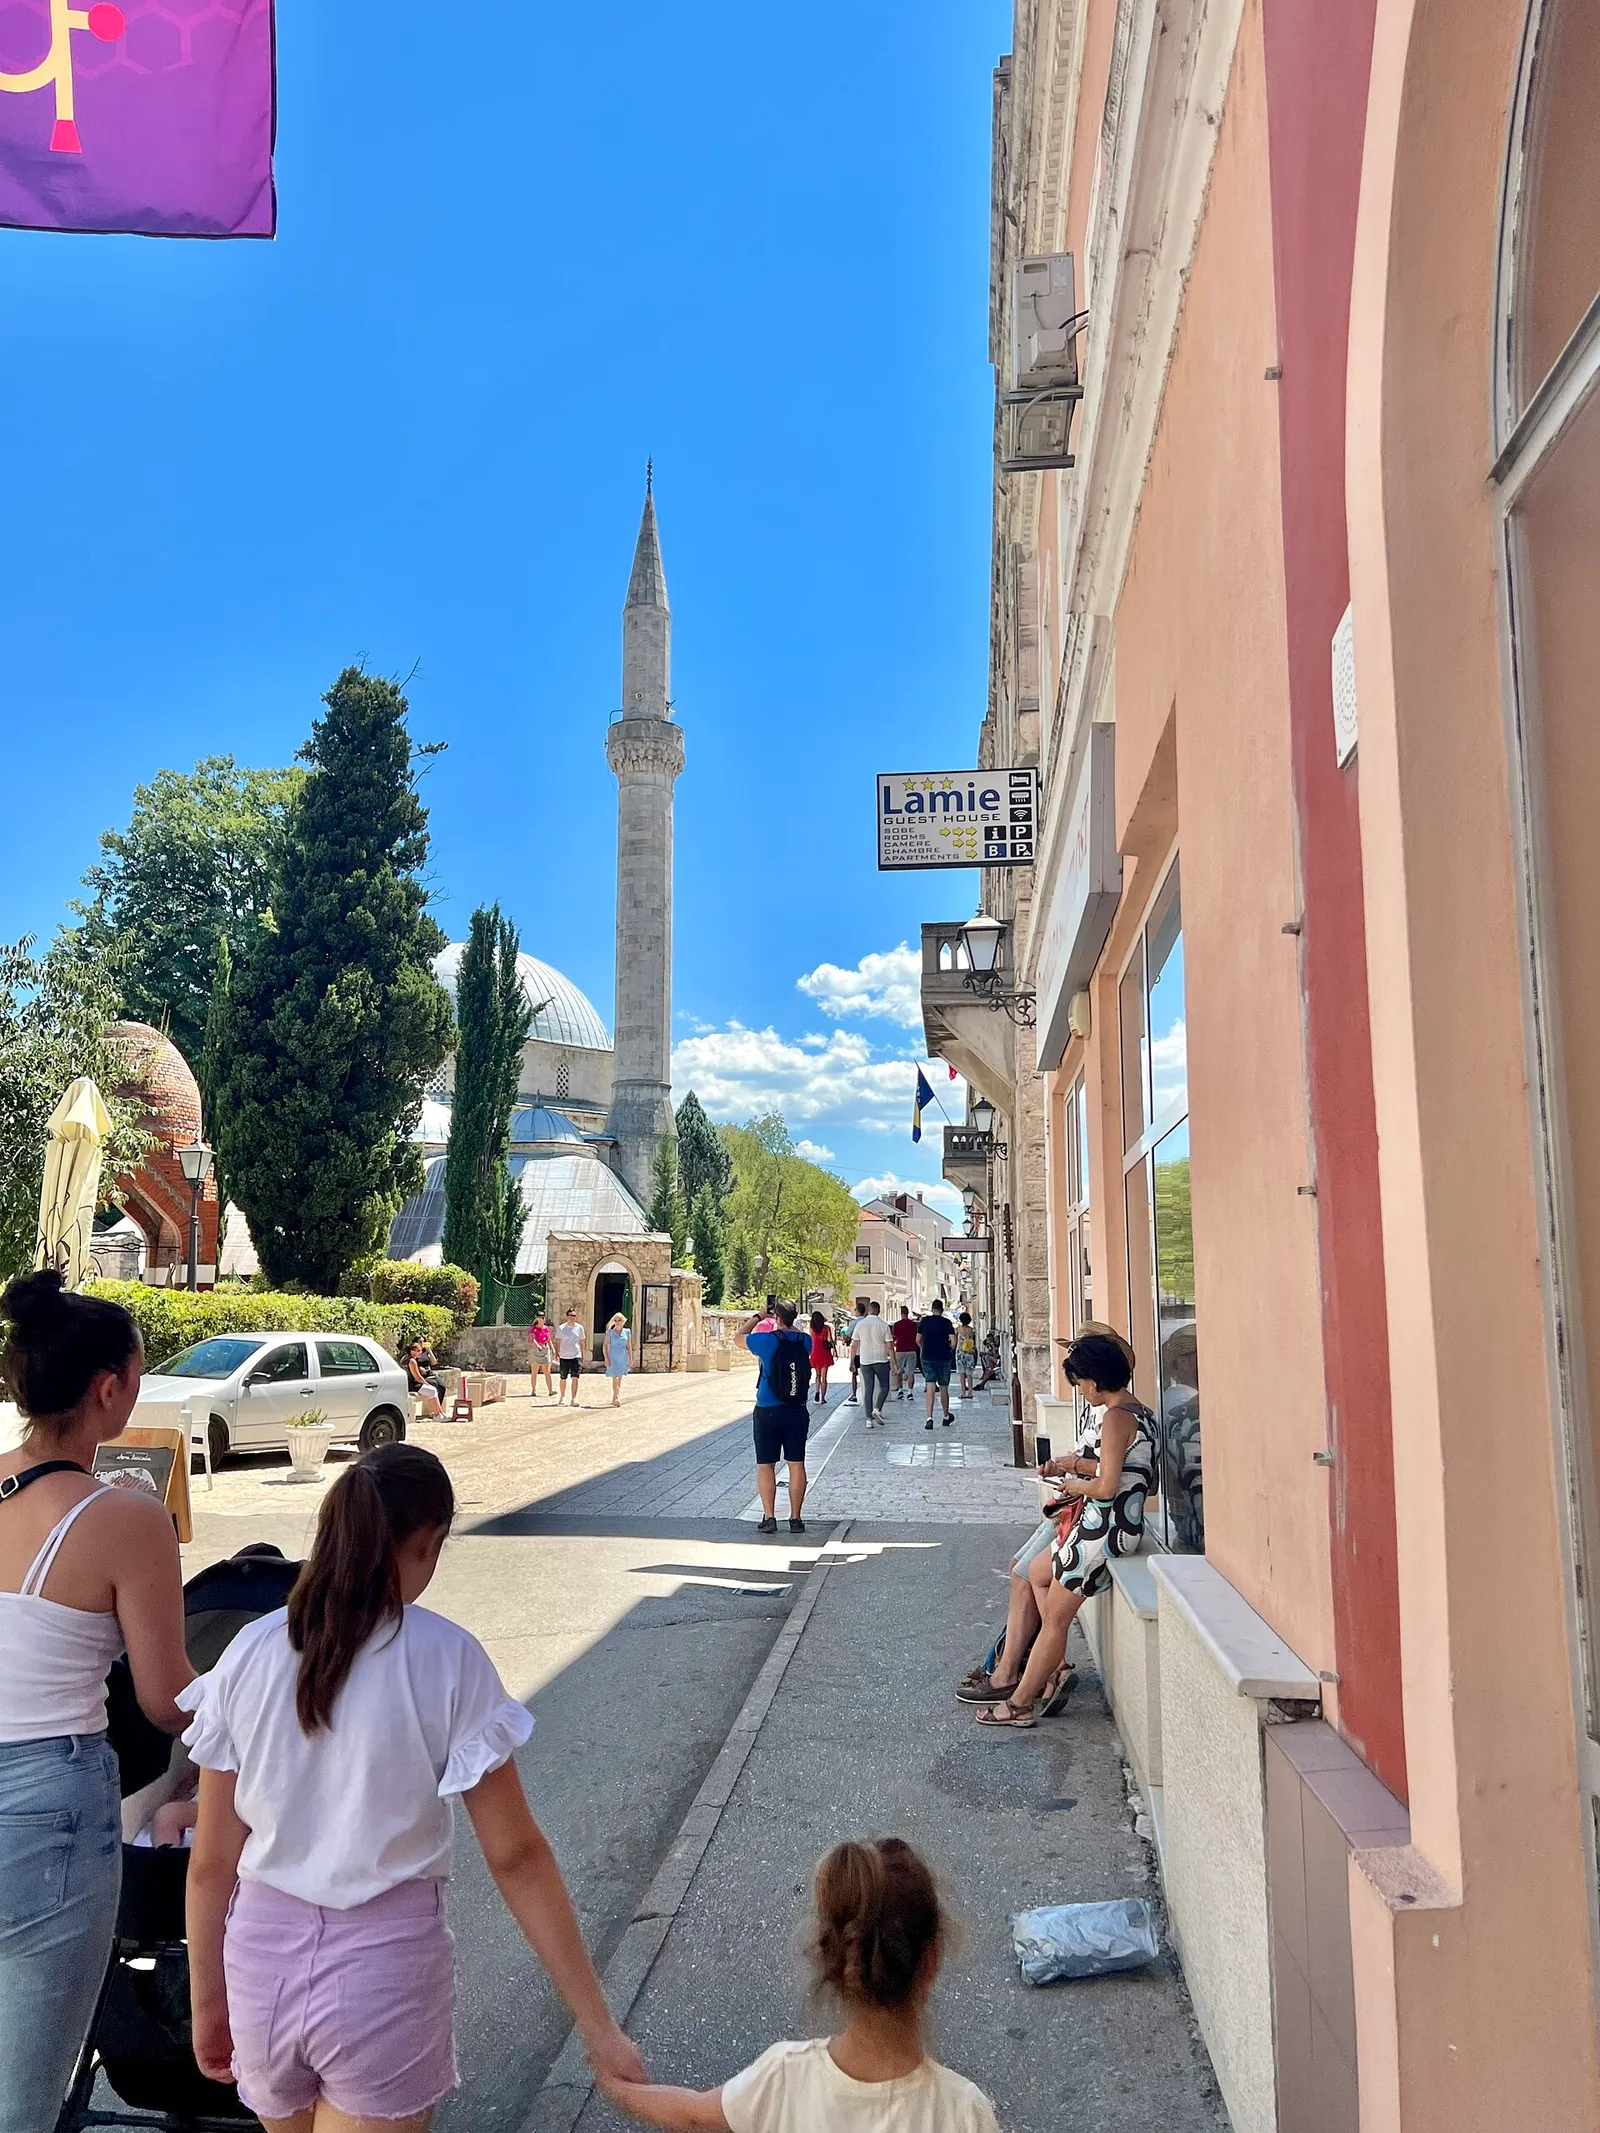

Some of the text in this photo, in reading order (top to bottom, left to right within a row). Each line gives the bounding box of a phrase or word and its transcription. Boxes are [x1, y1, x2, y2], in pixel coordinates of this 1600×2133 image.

[883, 782, 1000, 815] Lamie
[884, 813, 1001, 825] GUEST HOUSE
[884, 833, 926, 841] ROOMS
[1015, 826, 1027, 839] P
[884, 840, 931, 848] CAMERE
[884, 847, 940, 855] CHAMBRE
[884, 853, 960, 862] APARTMENTS
